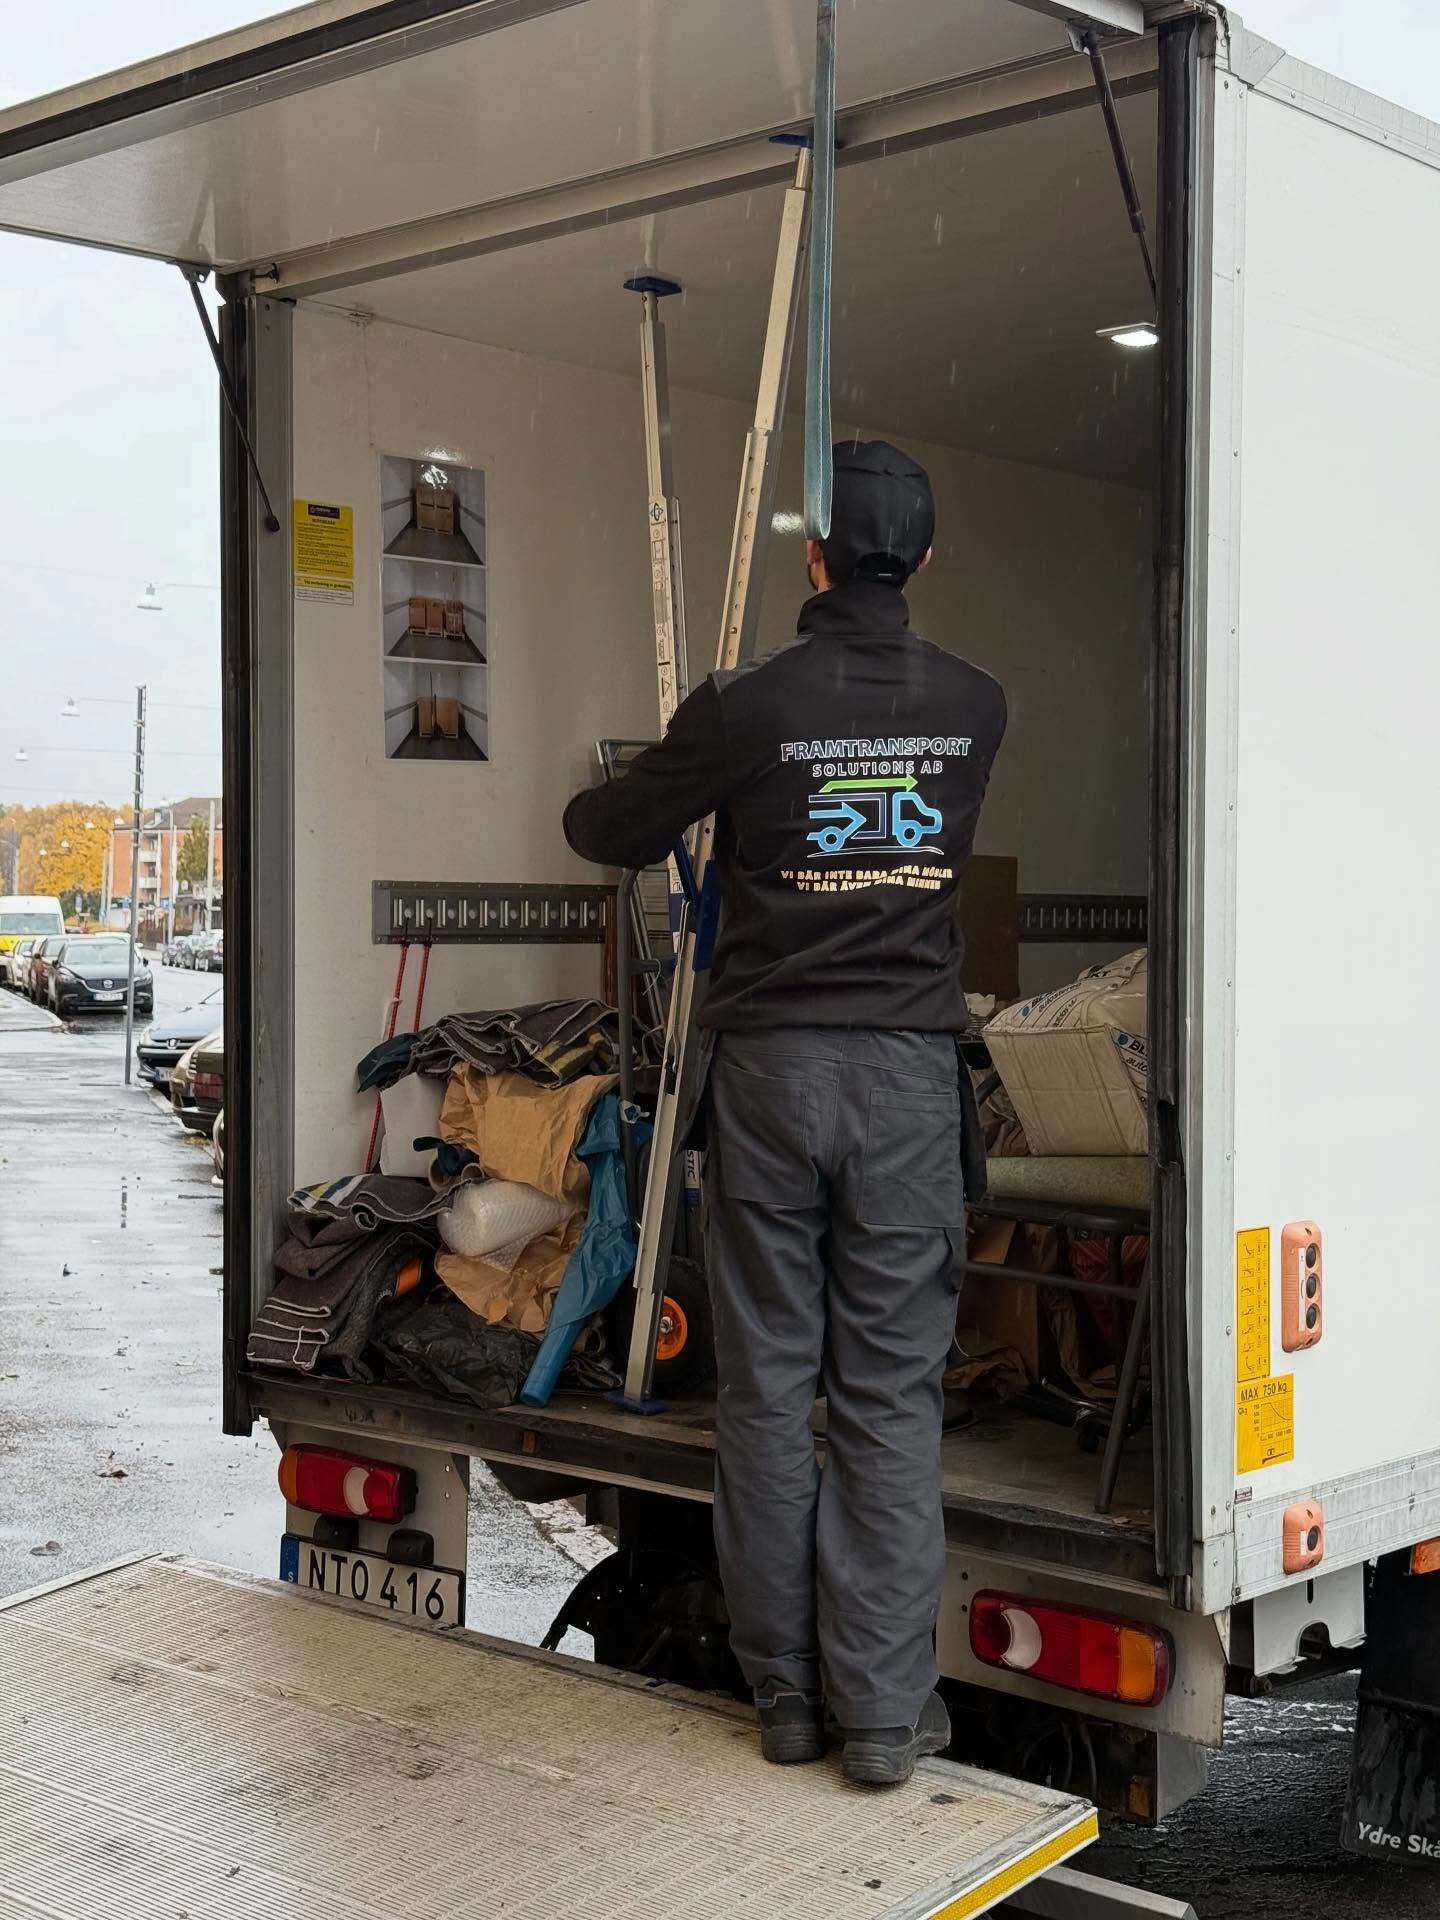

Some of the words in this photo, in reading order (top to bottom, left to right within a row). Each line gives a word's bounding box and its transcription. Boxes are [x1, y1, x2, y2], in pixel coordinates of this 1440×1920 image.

[781, 737, 972, 761] FRAMTRANSPORT
[812, 760, 915, 777] SOLUTIONS
[920, 760, 943, 774] AB
[781, 870, 793, 879] VI
[797, 870, 821, 880] BÄR
[825, 870, 852, 880] INTE
[856, 870, 887, 880] BARA
[797, 881, 809, 891] VI
[813, 881, 837, 892] BÄR
[1241, 1387, 1259, 1401] MAX
[1263, 1383, 1276, 1397] 750
[1278, 1381, 1287, 1392] kg
[287, 1571, 294, 1583] S
[309, 1549, 369, 1601] NTO
[380, 1567, 444, 1620] 416
[1358, 1821, 1401, 1849] Ydre
